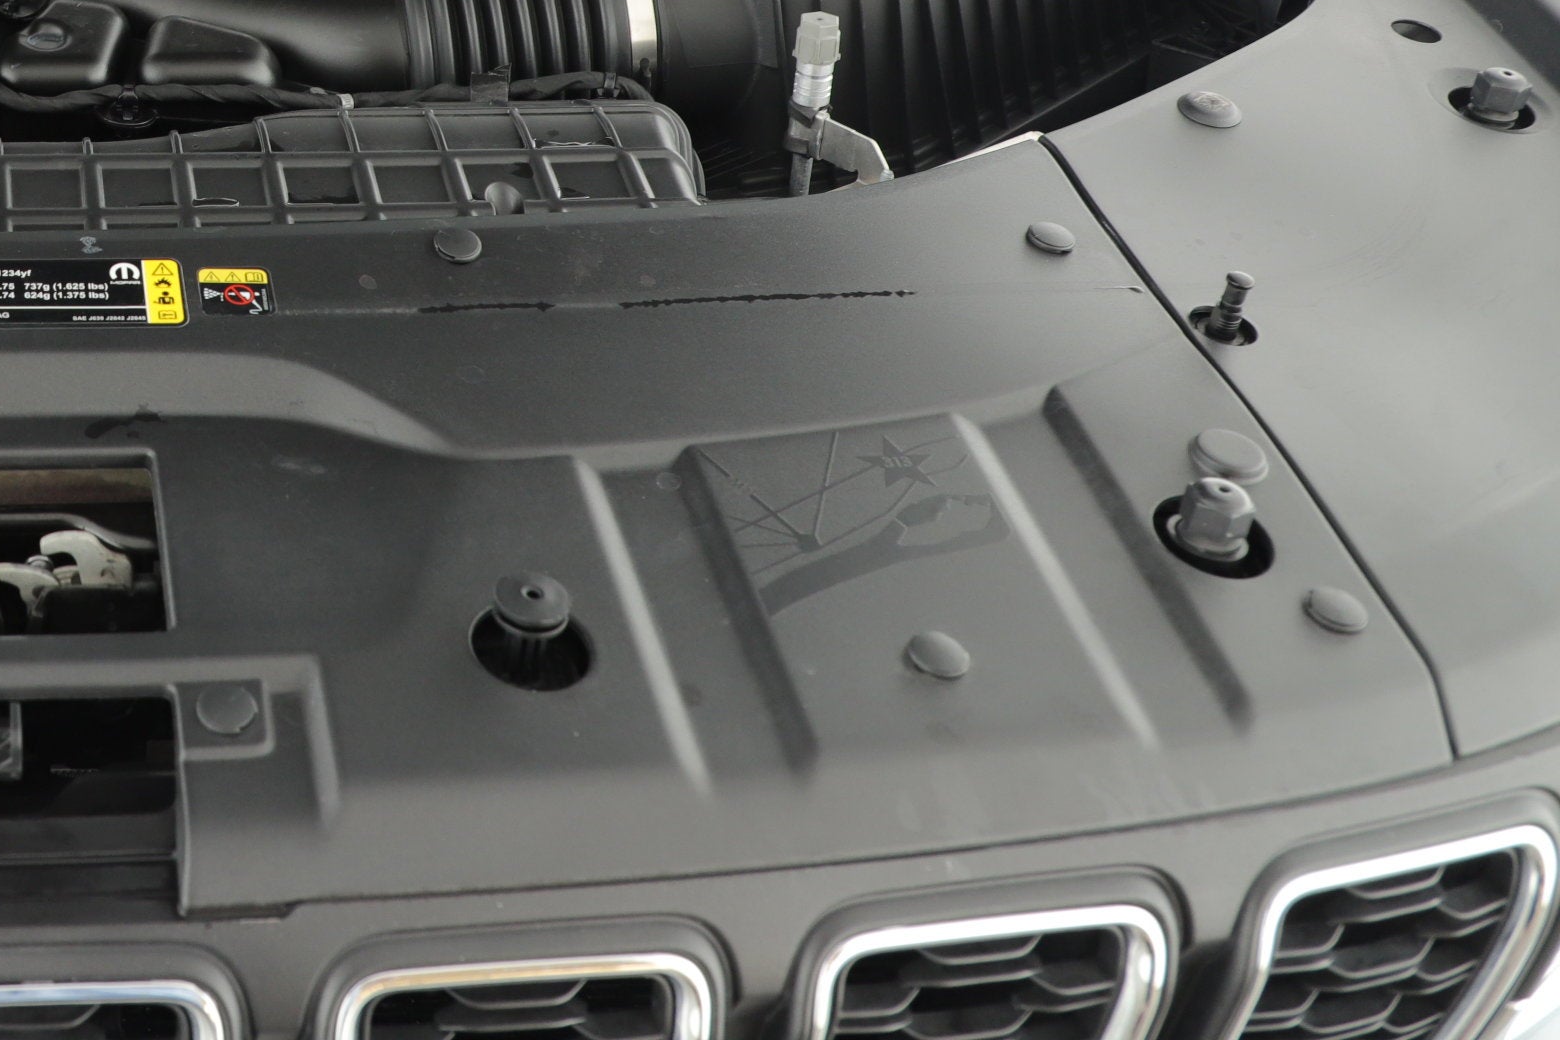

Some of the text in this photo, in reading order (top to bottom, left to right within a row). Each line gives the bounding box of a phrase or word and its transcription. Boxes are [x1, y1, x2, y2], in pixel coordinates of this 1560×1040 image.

[23, 282, 51, 292] 737g
[52, 282, 86, 292] (1.625
[87, 282, 109, 292] lbs)
[24, 291, 51, 300] 624g
[53, 291, 86, 300] (1.375
[88, 291, 109, 300] lbs)
[881, 456, 913, 468] 313
